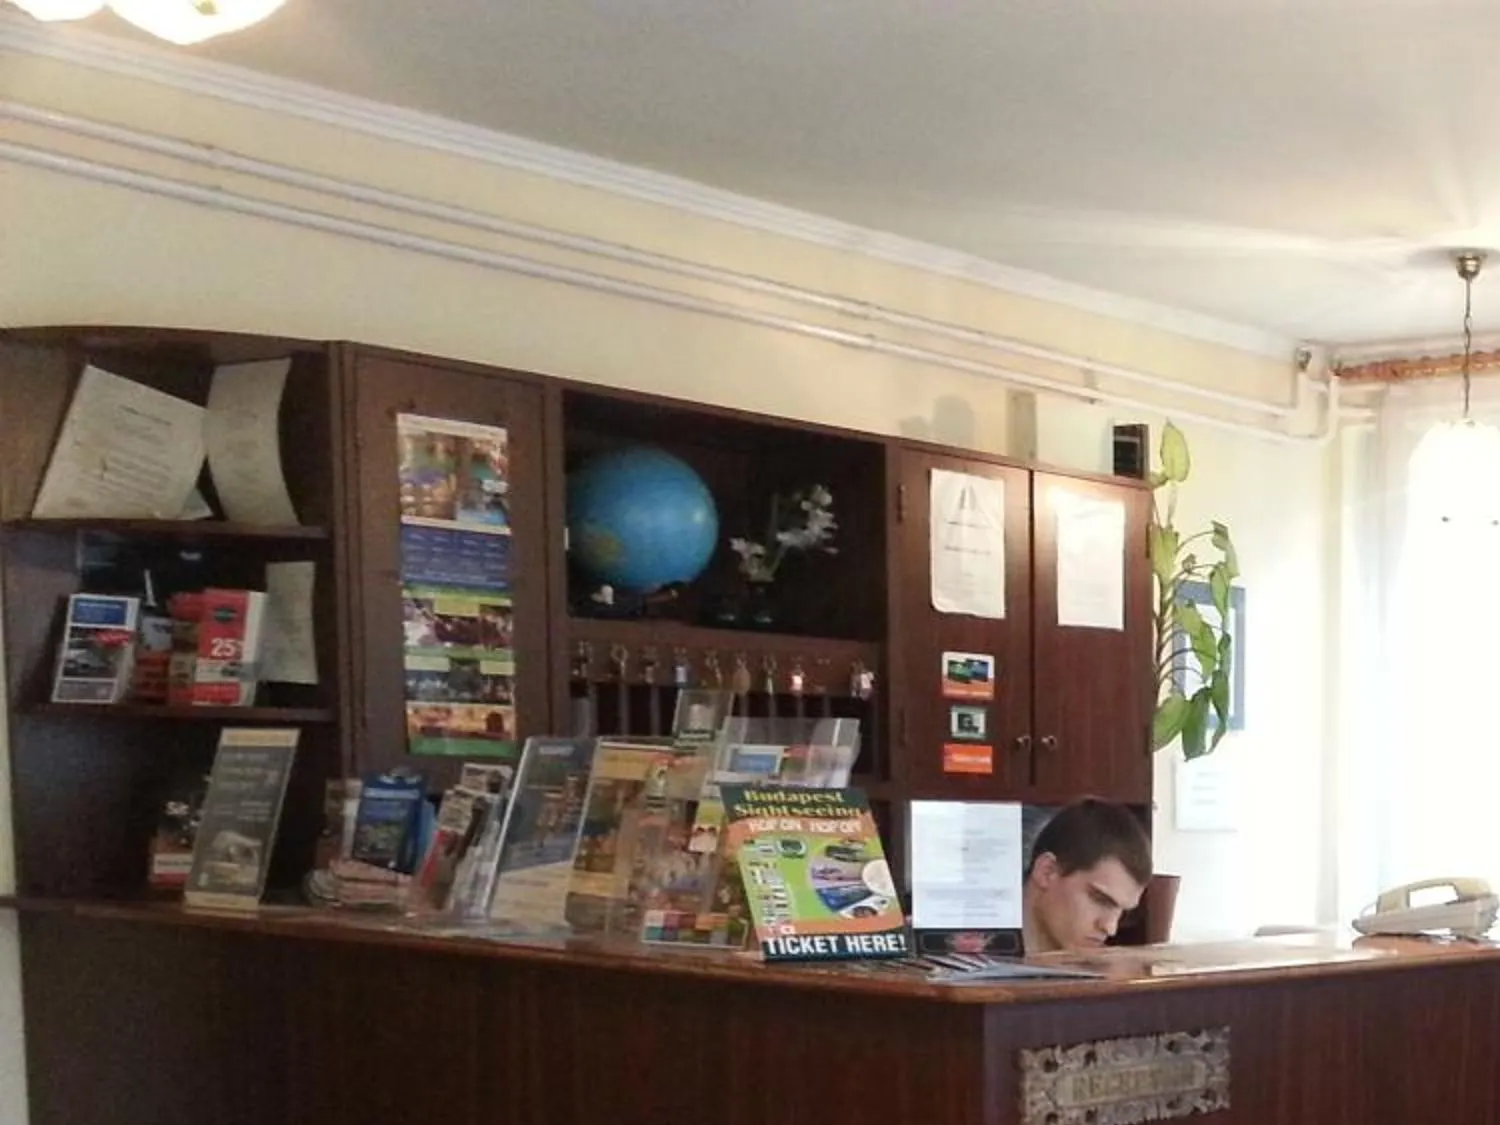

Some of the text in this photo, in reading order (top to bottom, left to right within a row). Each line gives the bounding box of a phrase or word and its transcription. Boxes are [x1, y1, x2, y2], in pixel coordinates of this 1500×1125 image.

[743, 790, 844, 804] Budapest
[767, 933, 907, 955] TICKET HERE!
